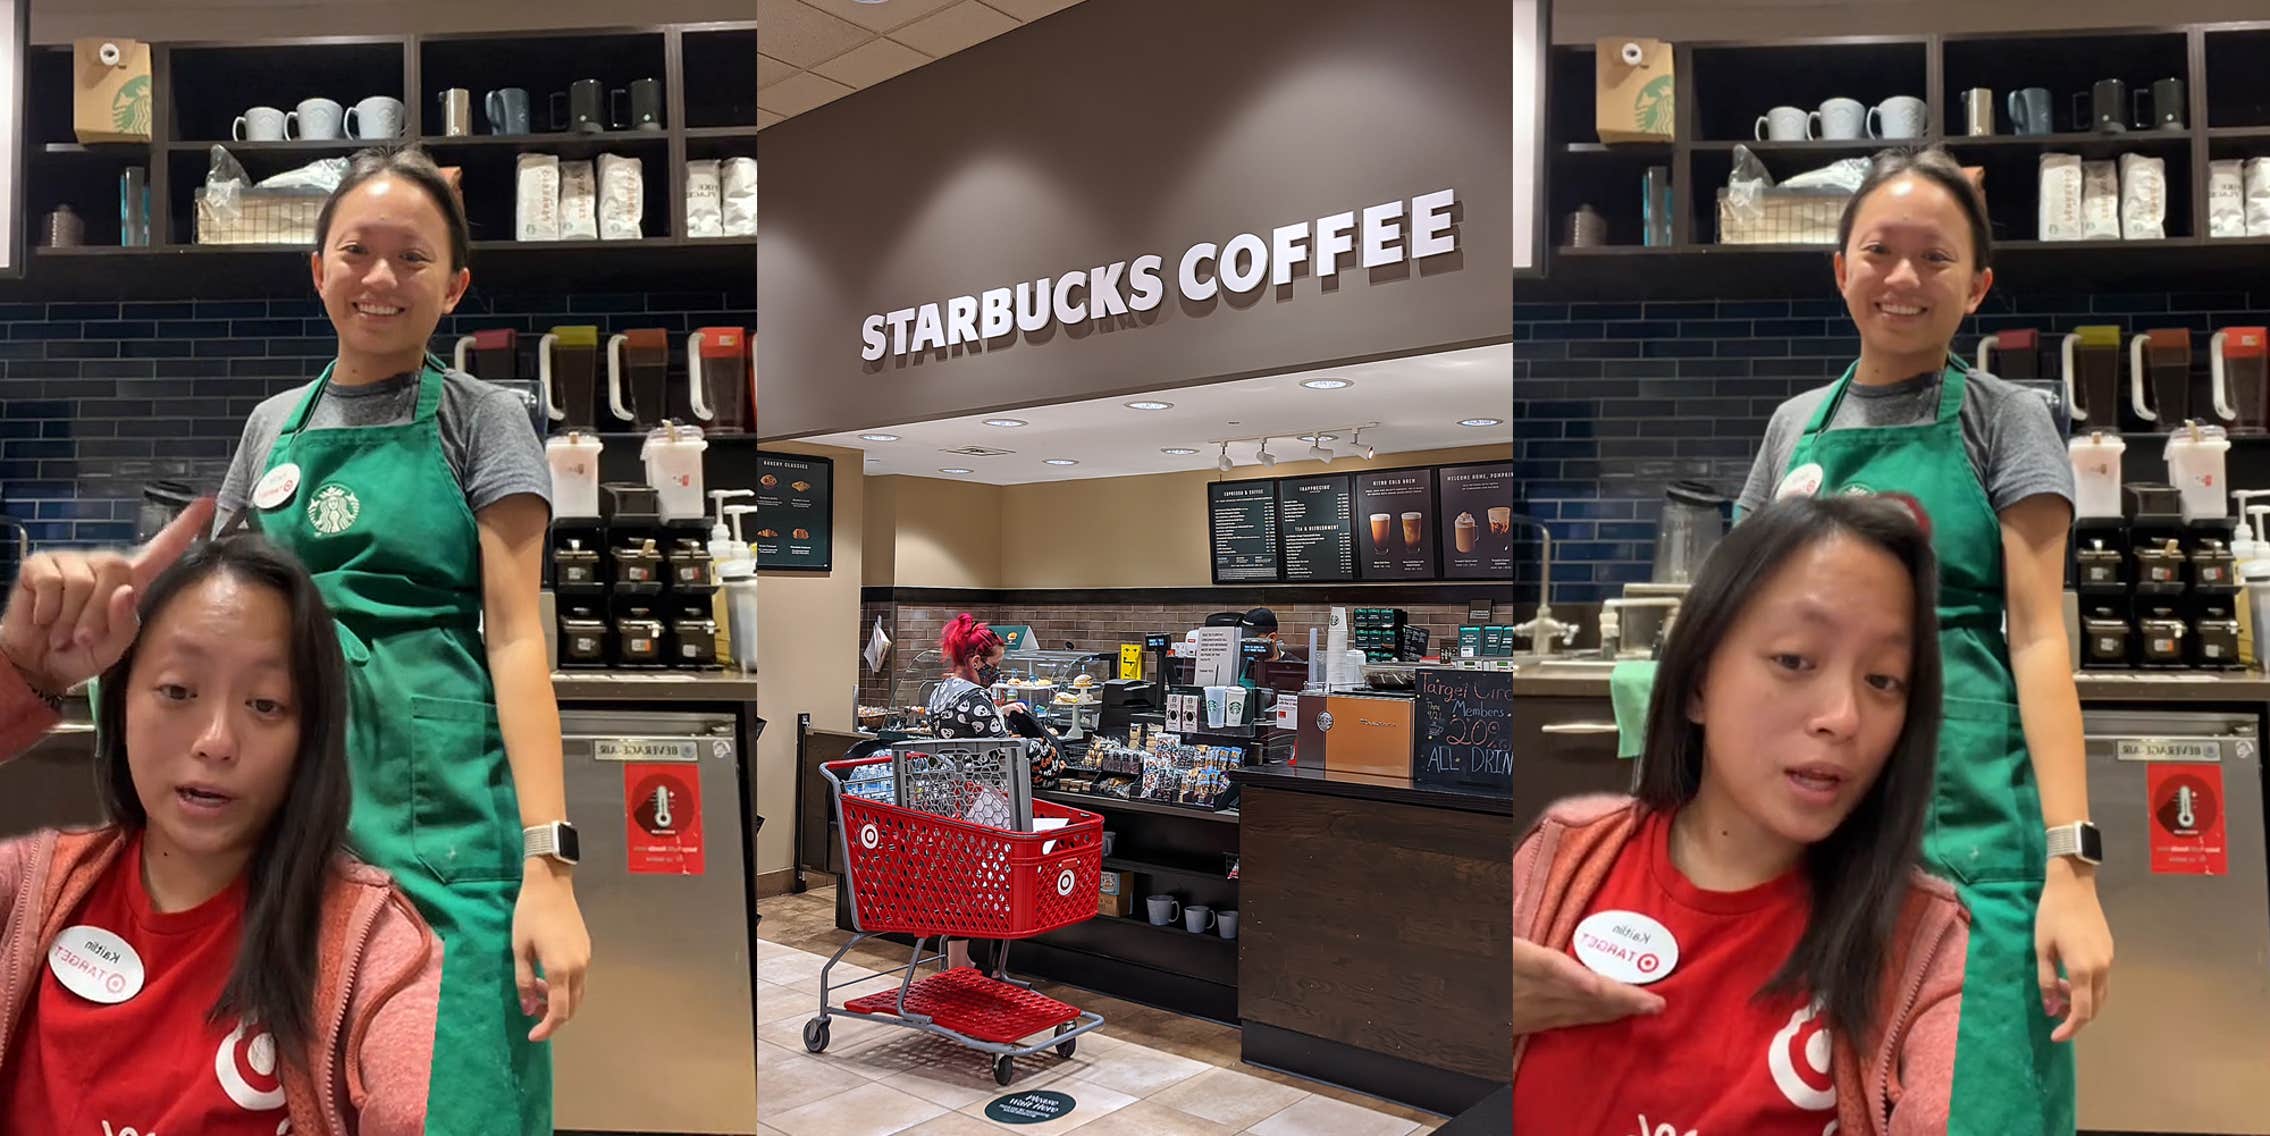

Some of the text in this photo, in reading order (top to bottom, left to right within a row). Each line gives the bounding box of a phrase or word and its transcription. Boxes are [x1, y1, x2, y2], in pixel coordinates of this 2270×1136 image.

[861, 188, 1455, 361] STARBUCKS COFFEE
[784, 461, 808, 470] CLASSICS
[1420, 672, 1469, 703] Target
[1452, 699, 1505, 718] Members
[1427, 746, 1513, 775] ALL DRIN
[1026, 1094, 1059, 1105] Please
